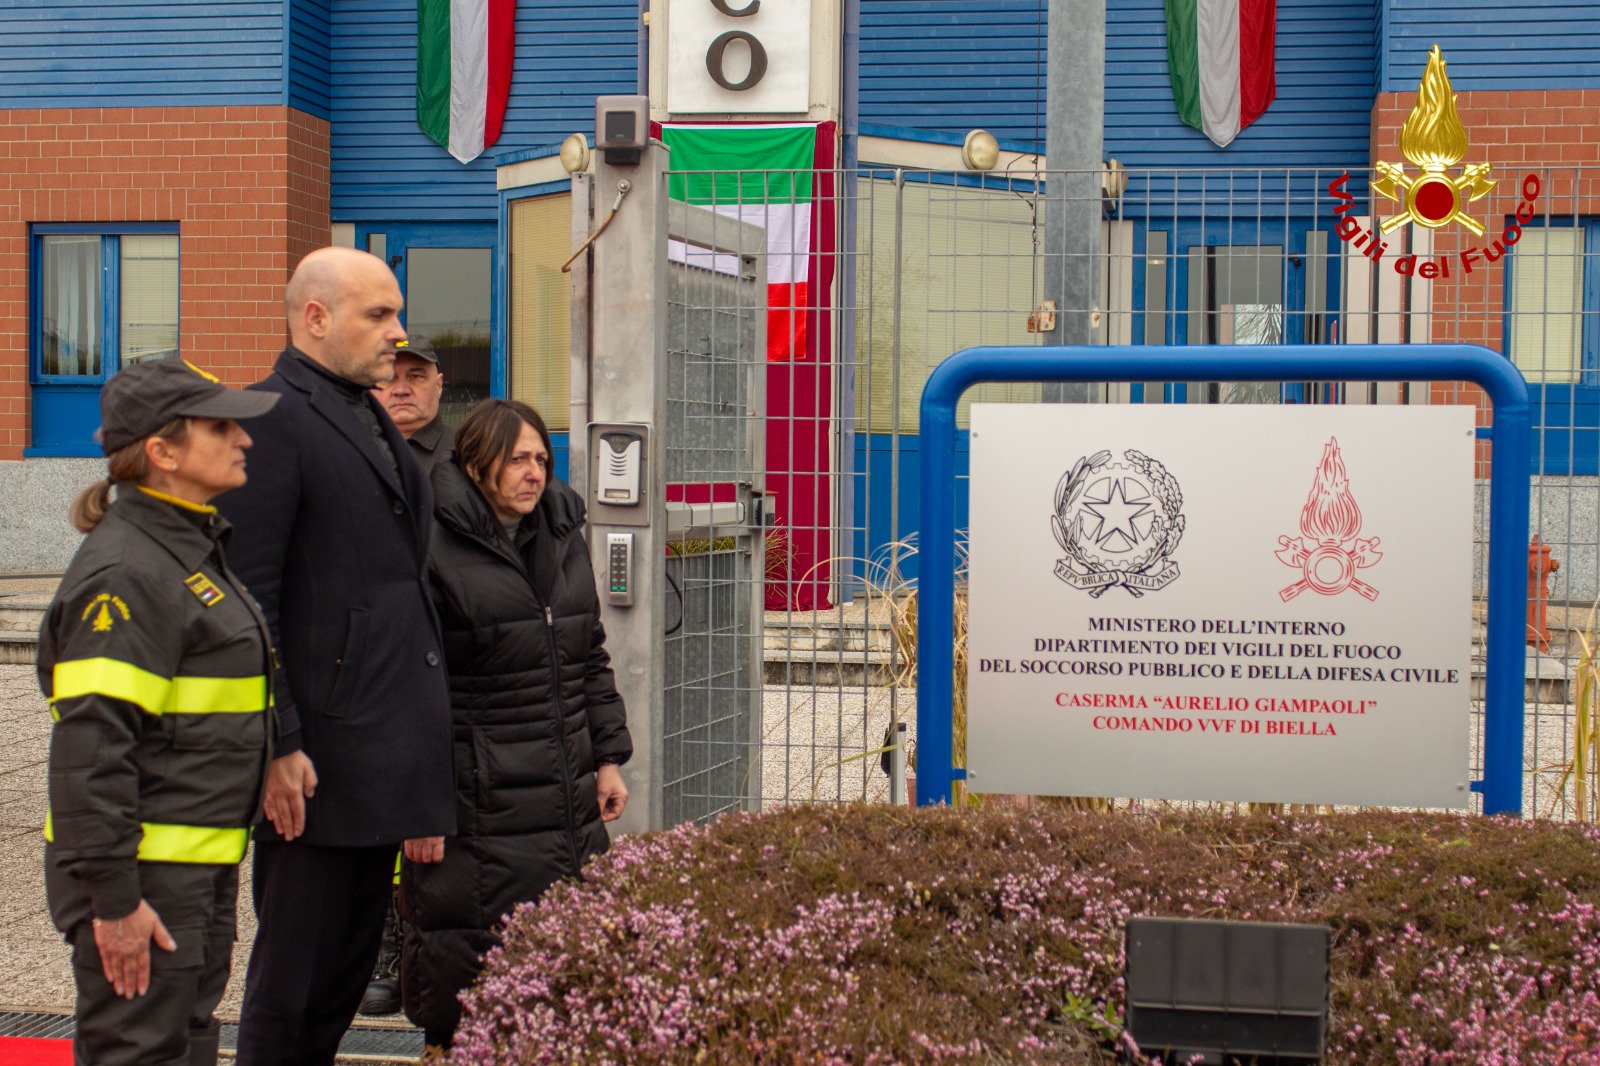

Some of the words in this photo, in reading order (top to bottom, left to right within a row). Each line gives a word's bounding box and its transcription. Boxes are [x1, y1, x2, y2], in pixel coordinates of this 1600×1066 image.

[706, 0, 768, 91] O
[1128, 568, 1177, 588] ITALIANA
[1088, 617, 1197, 634] MINISTERO
[1201, 619, 1346, 637] DELL’INTERNO
[1033, 638, 1180, 655] DIPARTIMENTO
[1184, 640, 1217, 656] DEI
[1221, 641, 1285, 658] VIGILI
[1289, 643, 1329, 658] DEL
[1332, 644, 1402, 660] FUOCO
[979, 658, 1017, 674] DEL
[1020, 659, 1124, 676] SOCCORSO
[1128, 662, 1226, 679] PUBBLICO
[1230, 664, 1243, 679] E
[1247, 664, 1313, 681] DELLA
[1316, 666, 1387, 682] DIFESA
[1390, 668, 1459, 684] CIVILE
[1055, 692, 1149, 709] CASERMA
[1153, 695, 1250, 712] “AURELIO
[1254, 697, 1378, 715] GIAMPAOLI”
[1092, 715, 1193, 732] COMANDO
[1197, 717, 1236, 734] VVF
[1240, 719, 1260, 734] DI
[1266, 720, 1337, 736] BIELLA
